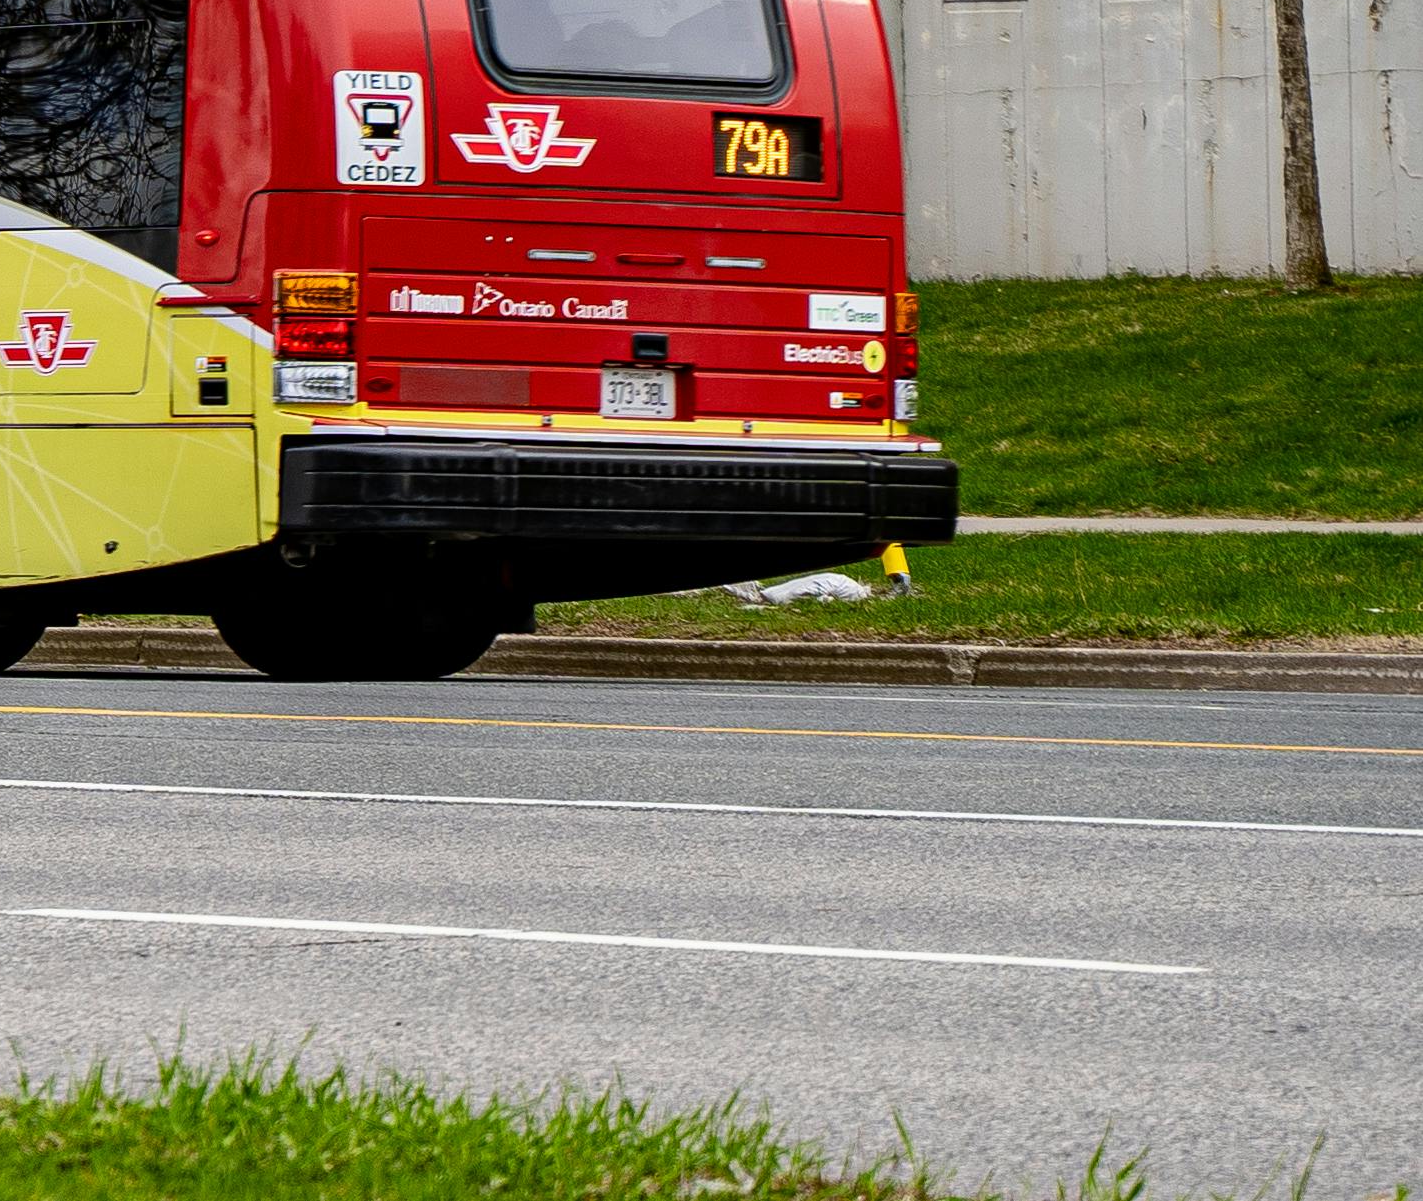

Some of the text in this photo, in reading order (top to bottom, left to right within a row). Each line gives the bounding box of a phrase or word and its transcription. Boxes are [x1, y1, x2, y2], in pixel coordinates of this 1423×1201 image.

[346, 73, 412, 90] YIELD
[720, 120, 789, 176] 79A
[347, 161, 417, 182] CÉDEZ
[499, 299, 555, 318] Ontario
[561, 297, 629, 319] Canada
